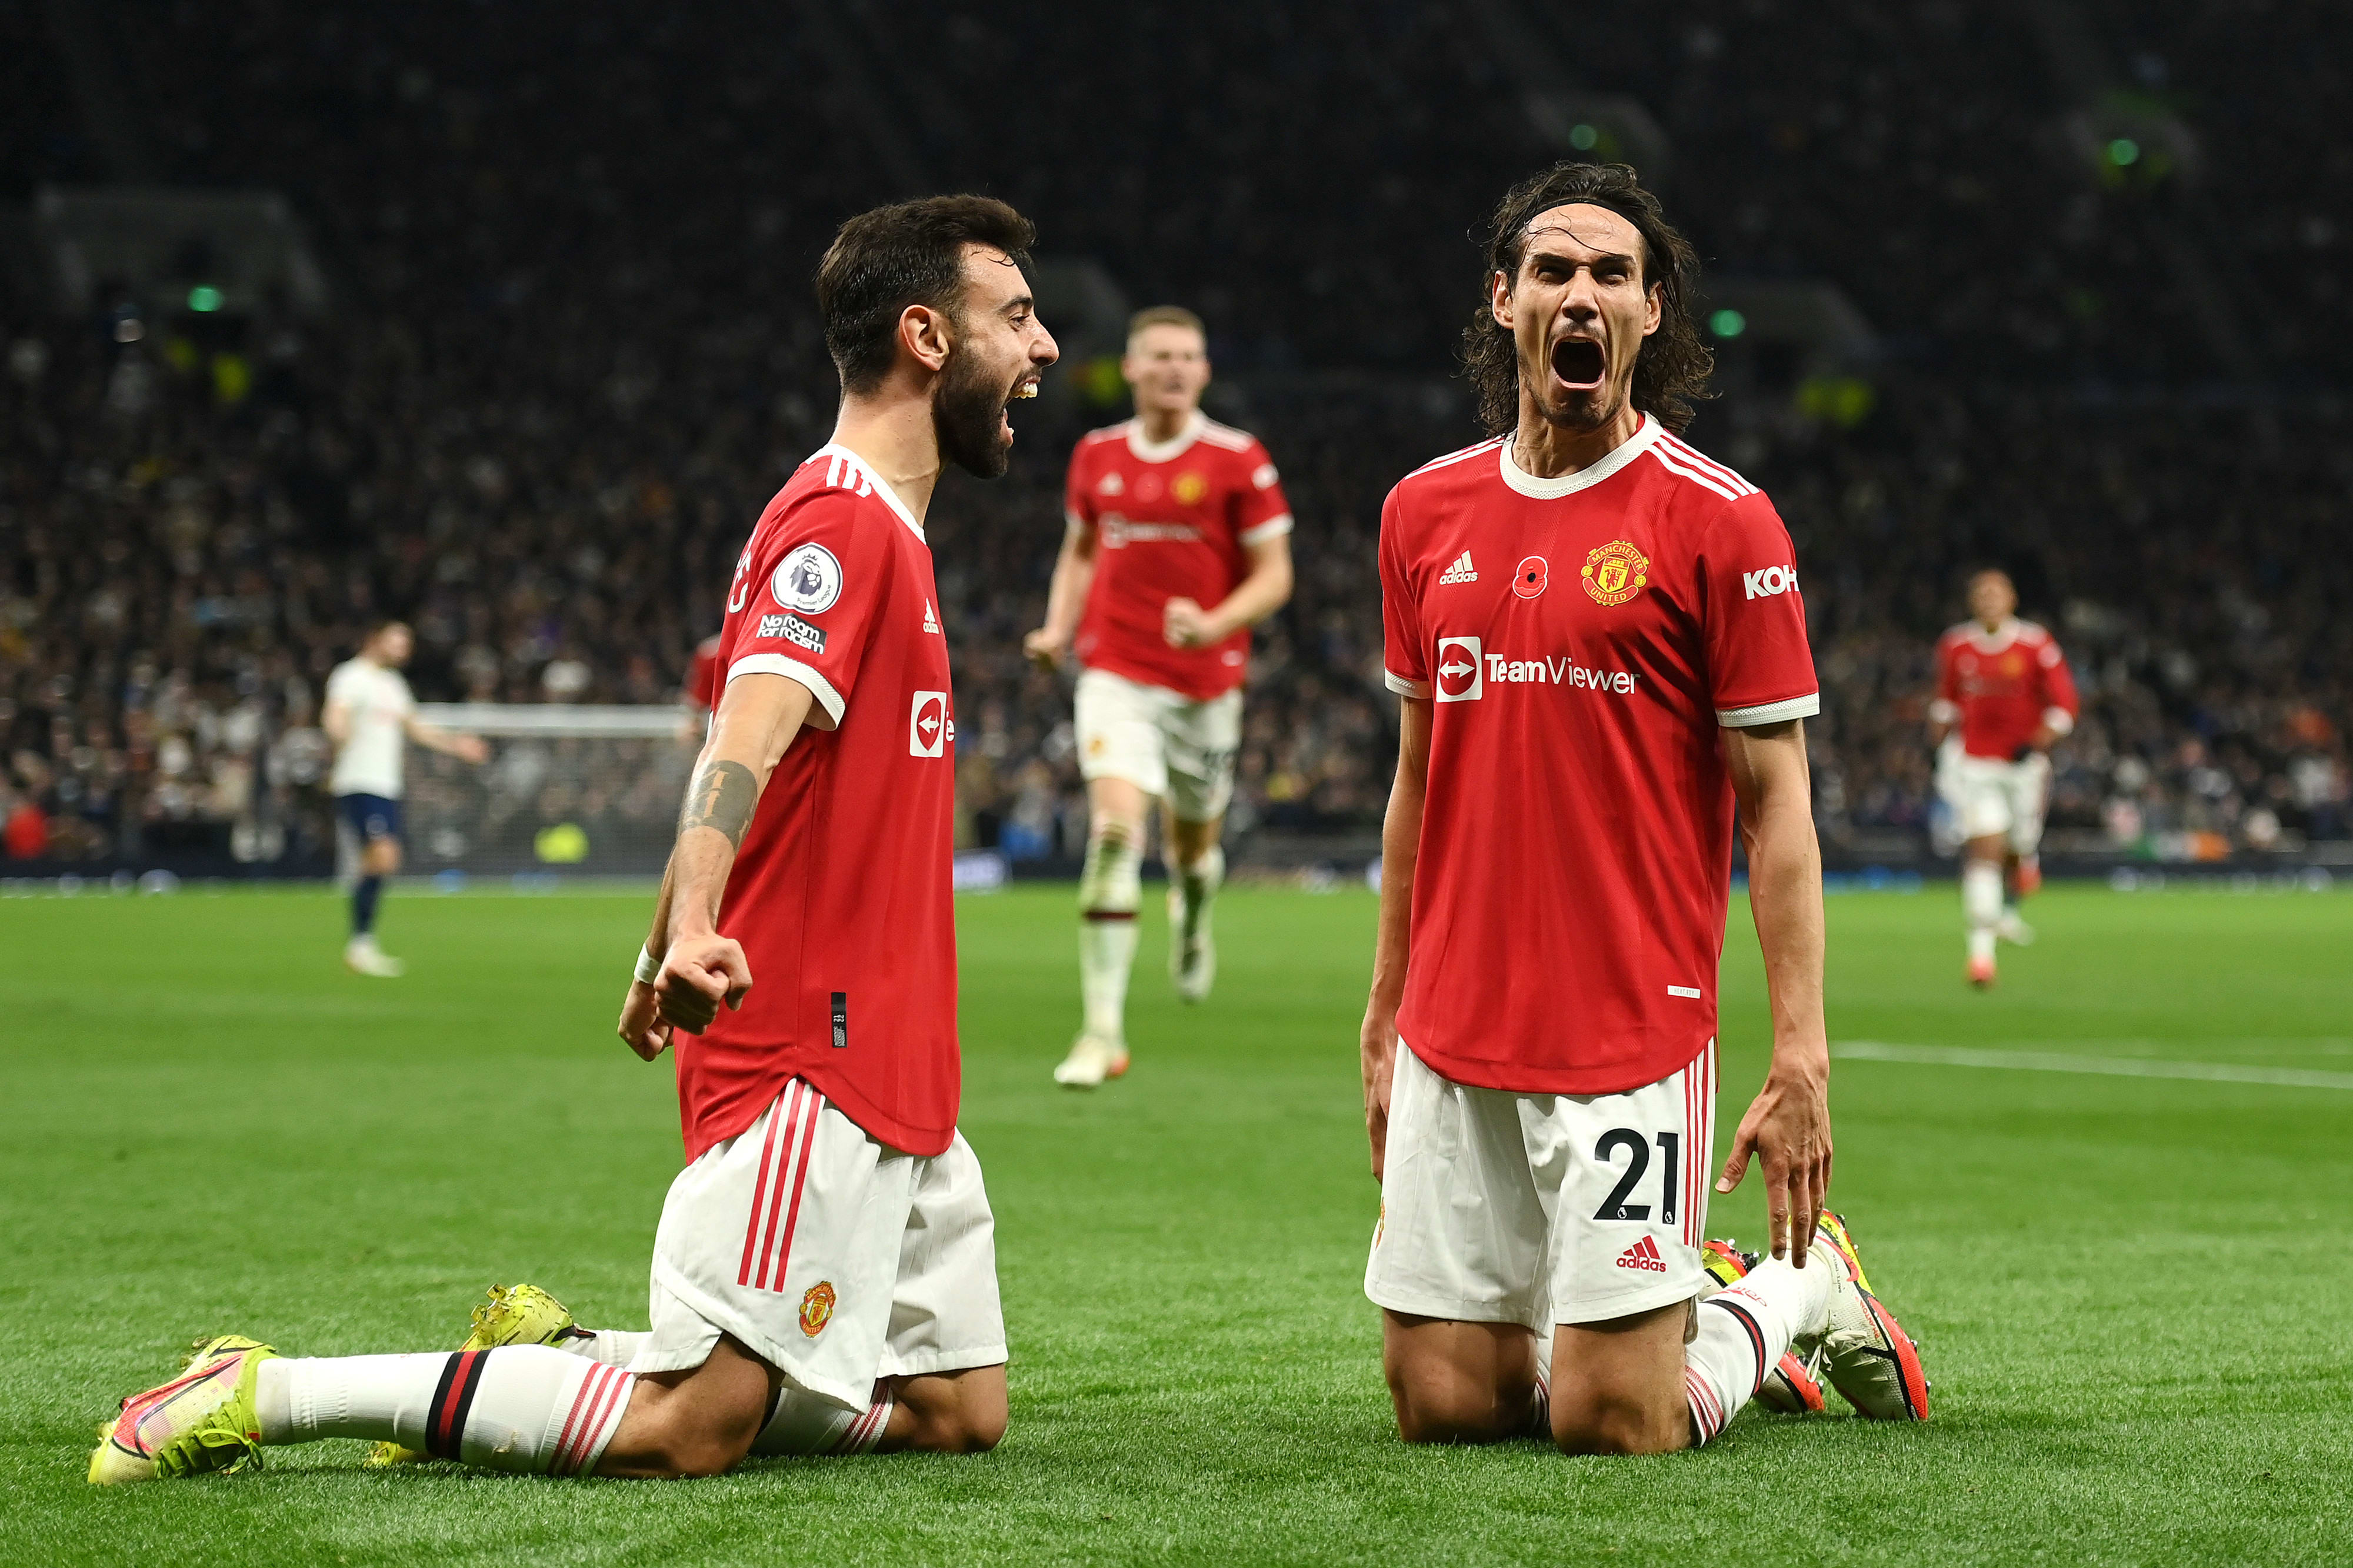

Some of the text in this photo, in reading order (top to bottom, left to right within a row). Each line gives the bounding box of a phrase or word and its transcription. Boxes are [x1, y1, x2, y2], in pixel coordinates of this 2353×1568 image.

[1591, 545, 1644, 571] MANCHESTER
[1439, 571, 1478, 585] adidas
[1590, 587, 1627, 602] UNITED
[760, 615, 820, 642] No room
[779, 626, 824, 655] racism
[1485, 653, 1641, 695] TeamViewer
[1592, 1128, 1678, 1225] 21
[1616, 1255, 1667, 1272] adidas
